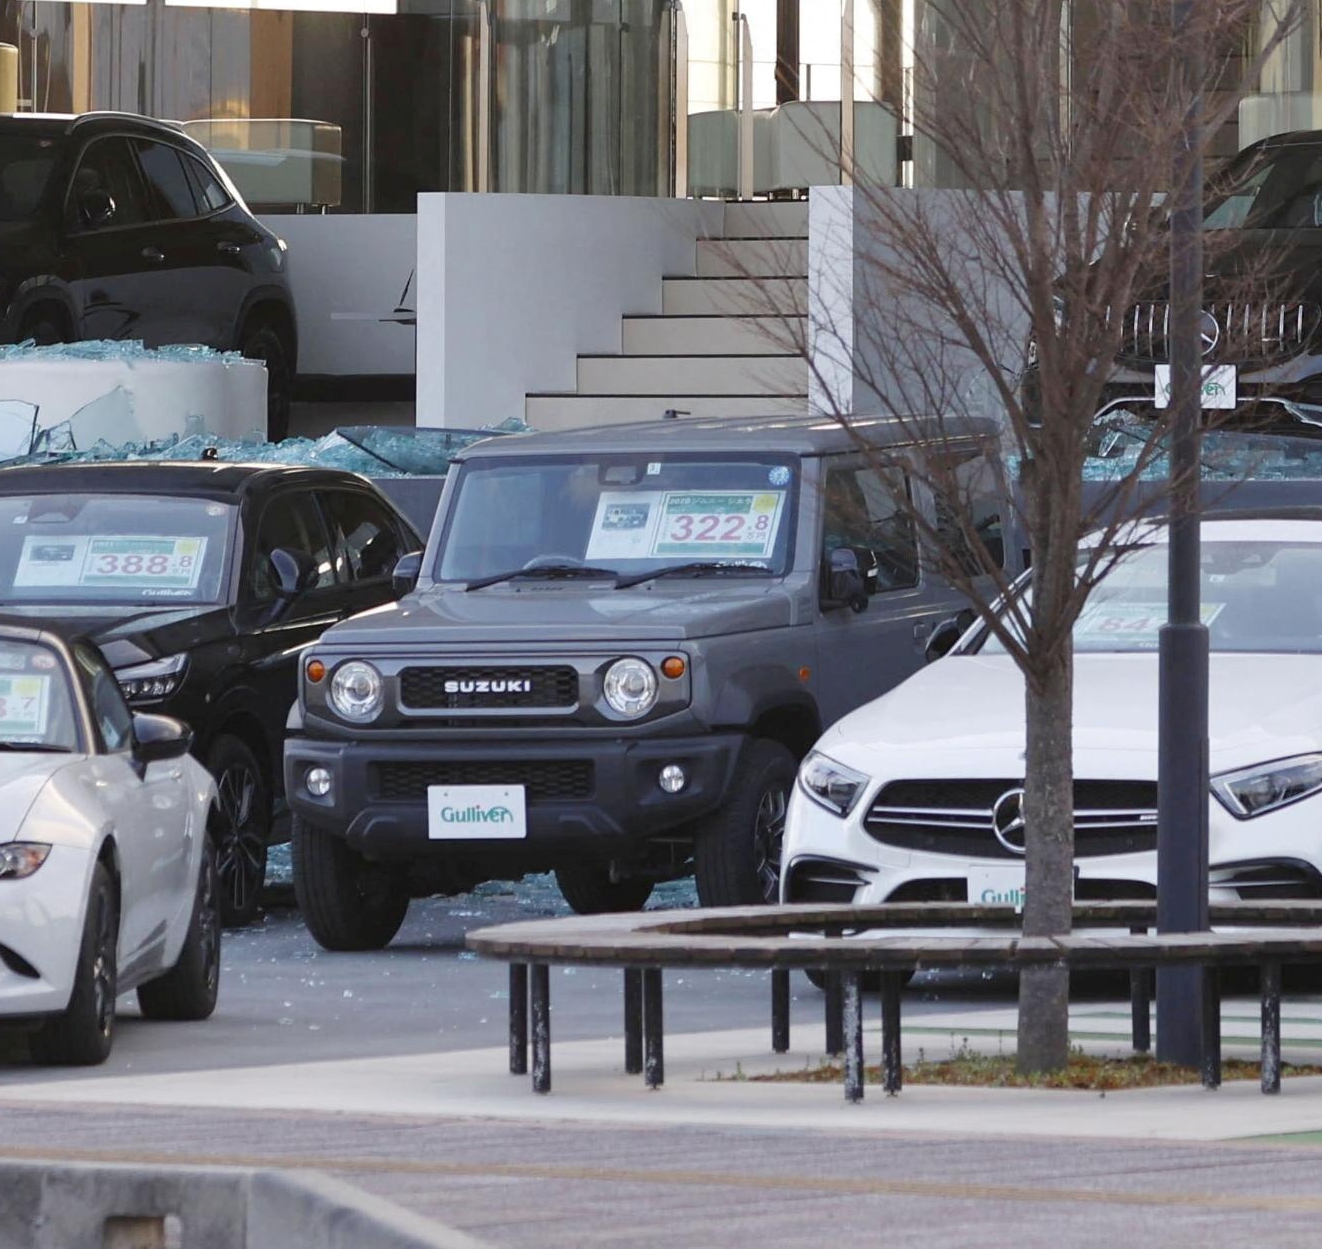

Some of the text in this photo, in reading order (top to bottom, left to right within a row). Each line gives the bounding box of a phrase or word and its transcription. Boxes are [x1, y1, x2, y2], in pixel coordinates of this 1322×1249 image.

[444, 680, 531, 693] SUZUKI
[440, 804, 514, 823] Gulliver
[981, 886, 1027, 904] Gulli
